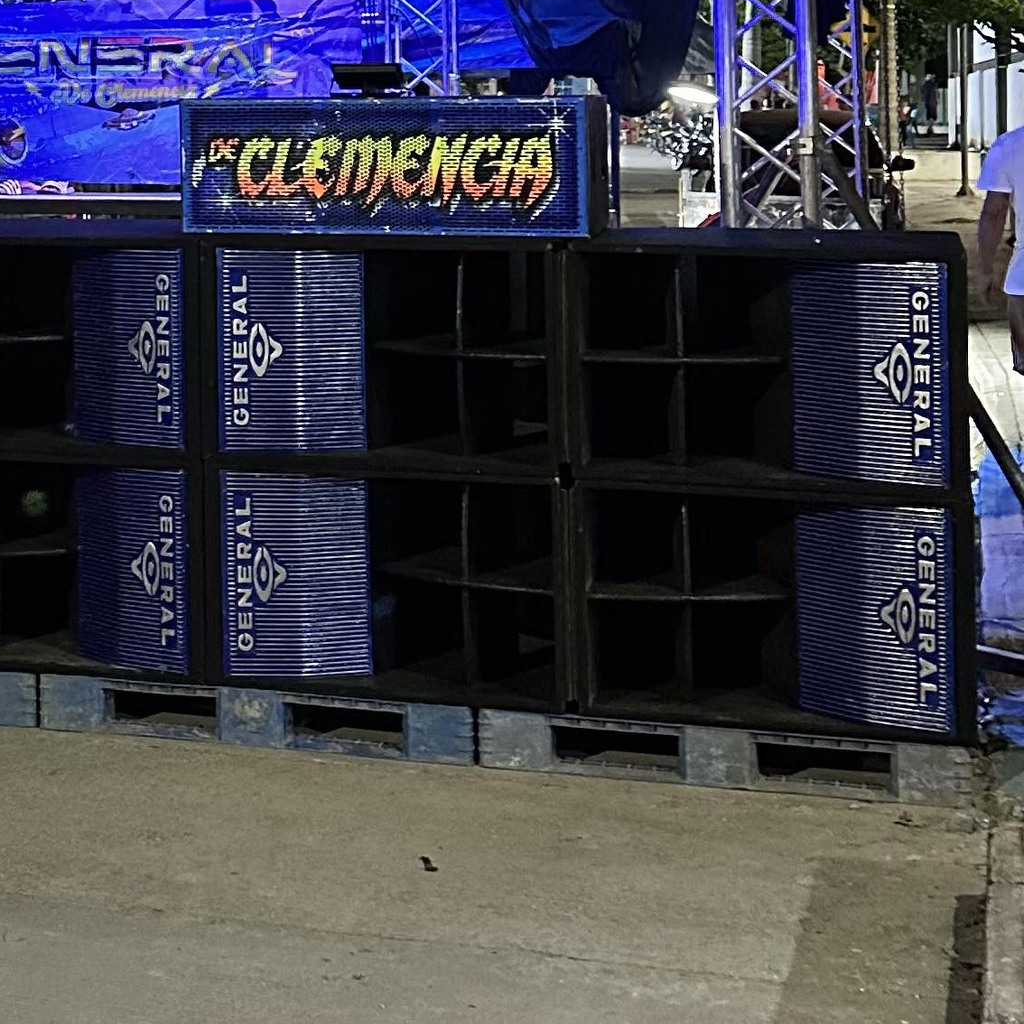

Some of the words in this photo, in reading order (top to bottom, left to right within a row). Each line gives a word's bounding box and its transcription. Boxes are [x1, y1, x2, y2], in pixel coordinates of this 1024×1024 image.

[237, 134, 554, 211] CLEMENCIA
[156, 274, 172, 423] GENERAL
[231, 275, 249, 426] GENERAL
[911, 290, 932, 457] GENERAL
[158, 495, 175, 646] GENERAL
[235, 497, 253, 652] GENERAL
[917, 535, 937, 703] GENERAL
